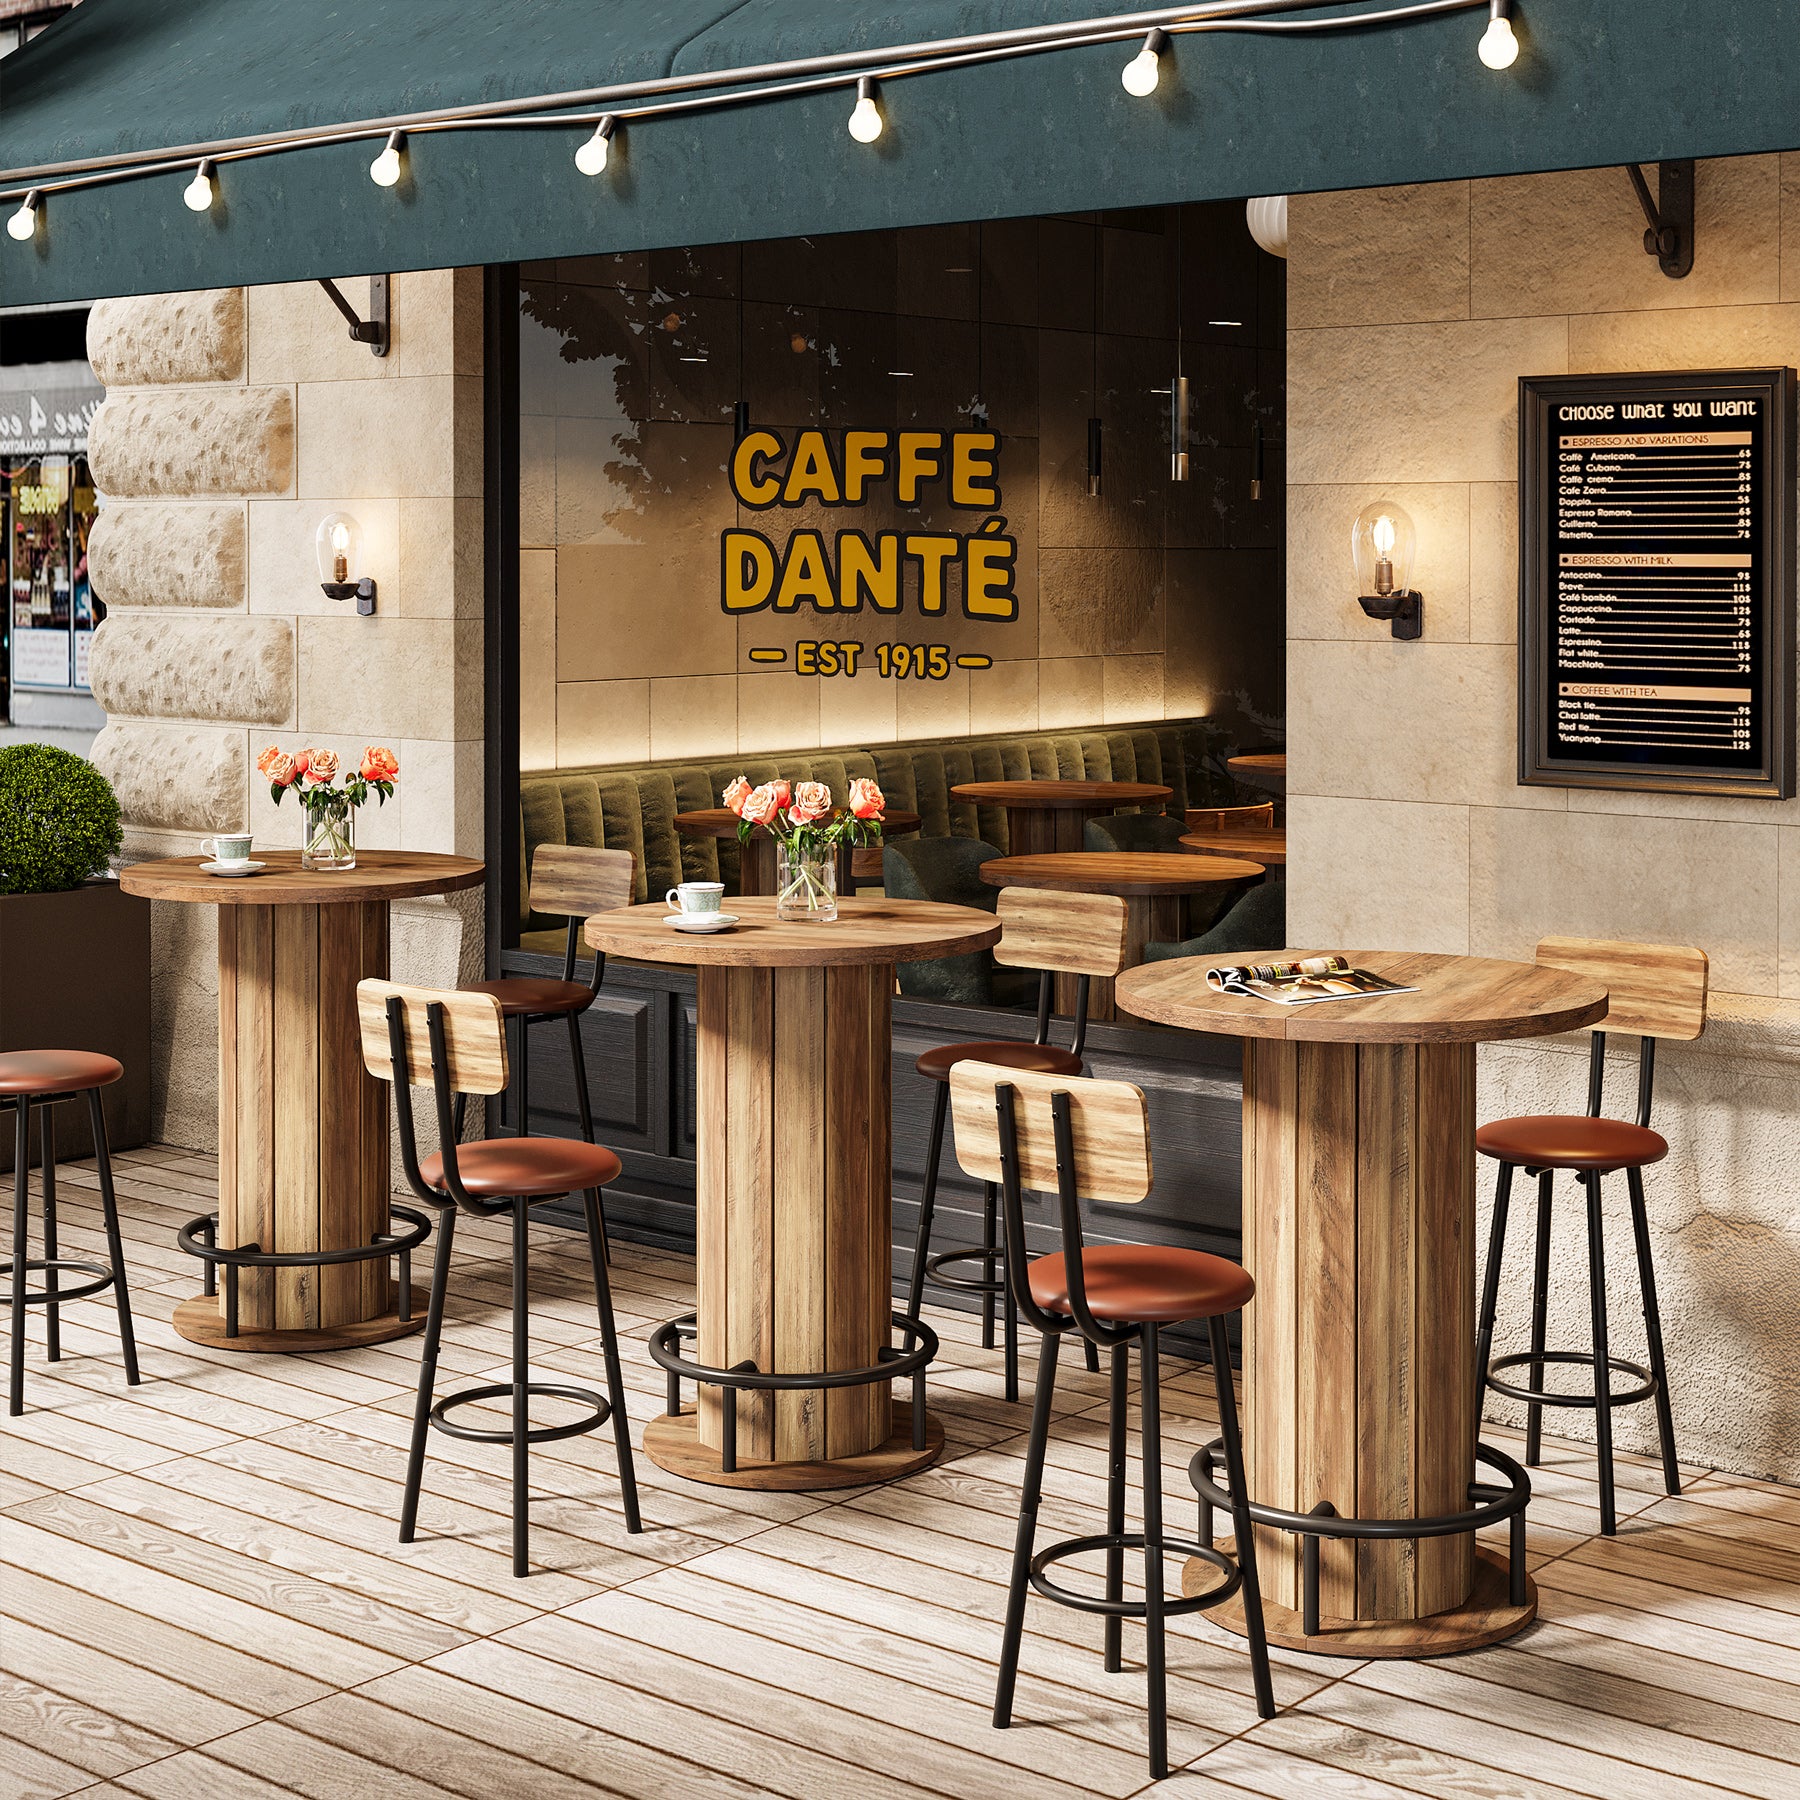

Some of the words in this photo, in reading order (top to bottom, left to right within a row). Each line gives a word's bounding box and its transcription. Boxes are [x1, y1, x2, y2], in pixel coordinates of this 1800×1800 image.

[1622, 404, 1665, 419] what
[1673, 402, 1702, 417] you
[1710, 400, 1757, 416] want
[1572, 437, 1621, 446] ESPRESSO
[1624, 436, 1646, 445] AND
[1649, 435, 1708, 444] VARIATIONS
[1590, 452, 1637, 460] Americano
[1739, 450, 1752, 458] 6$
[728, 427, 1002, 512] CAFFE
[1586, 464, 1621, 472] Cubano
[1739, 461, 1752, 469] 7$
[1738, 472, 1752, 481] 8$
[1583, 486, 1606, 495] Zorro
[1738, 484, 1752, 493] 6$
[1559, 498, 1591, 507] Doppio
[1737, 496, 1751, 504] 5$
[1559, 509, 1595, 518] Espresso
[1597, 509, 1632, 517] Romano
[1738, 507, 1752, 516] 6$
[1559, 519, 1598, 528] Guillermo
[1738, 519, 1751, 527] 8$
[1559, 531, 1593, 539] Ristretto
[1738, 530, 1751, 539] 7$
[1572, 555, 1621, 565] ESPRESSO
[1624, 556, 1648, 565] WITH
[1651, 556, 1673, 565] MILK
[721, 516, 1018, 622] DANTÉ
[1738, 572, 1751, 580] 9$
[1559, 582, 1583, 590] Breve
[1733, 584, 1751, 592] 11$
[1733, 595, 1751, 603] 10$
[1559, 605, 1612, 614] Cappuccino
[1733, 606, 1751, 615] 12$
[1559, 616, 1595, 624] Cortado
[1738, 618, 1751, 626] 7$
[1559, 627, 1581, 635] Latte
[1738, 630, 1751, 638] 6$
[1559, 638, 1602, 647] Espressino
[1732, 641, 1751, 650] 11$
[796, 640, 863, 677] EST
[875, 642, 950, 680] 1915
[1559, 649, 1575, 657] Flat
[1577, 650, 1599, 658] white
[1738, 653, 1751, 661] 9$
[1559, 660, 1604, 669] Macchiato
[1738, 664, 1751, 673] 7$
[1572, 685, 1610, 695] COFFEE
[1613, 687, 1636, 696] WITH
[1640, 688, 1657, 697] TEA
[1559, 700, 1581, 709] Black
[1584, 701, 1595, 709] tie
[1738, 706, 1751, 715] 9$
[1559, 712, 1579, 720] Chai
[1580, 712, 1600, 721] latte
[1733, 718, 1751, 727] 11$
[1559, 723, 1576, 731] Red
[1579, 724, 1590, 732] tie
[1733, 729, 1751, 738] 10$
[1559, 734, 1601, 745] Yuanyang
[1733, 741, 1751, 750] 12$
